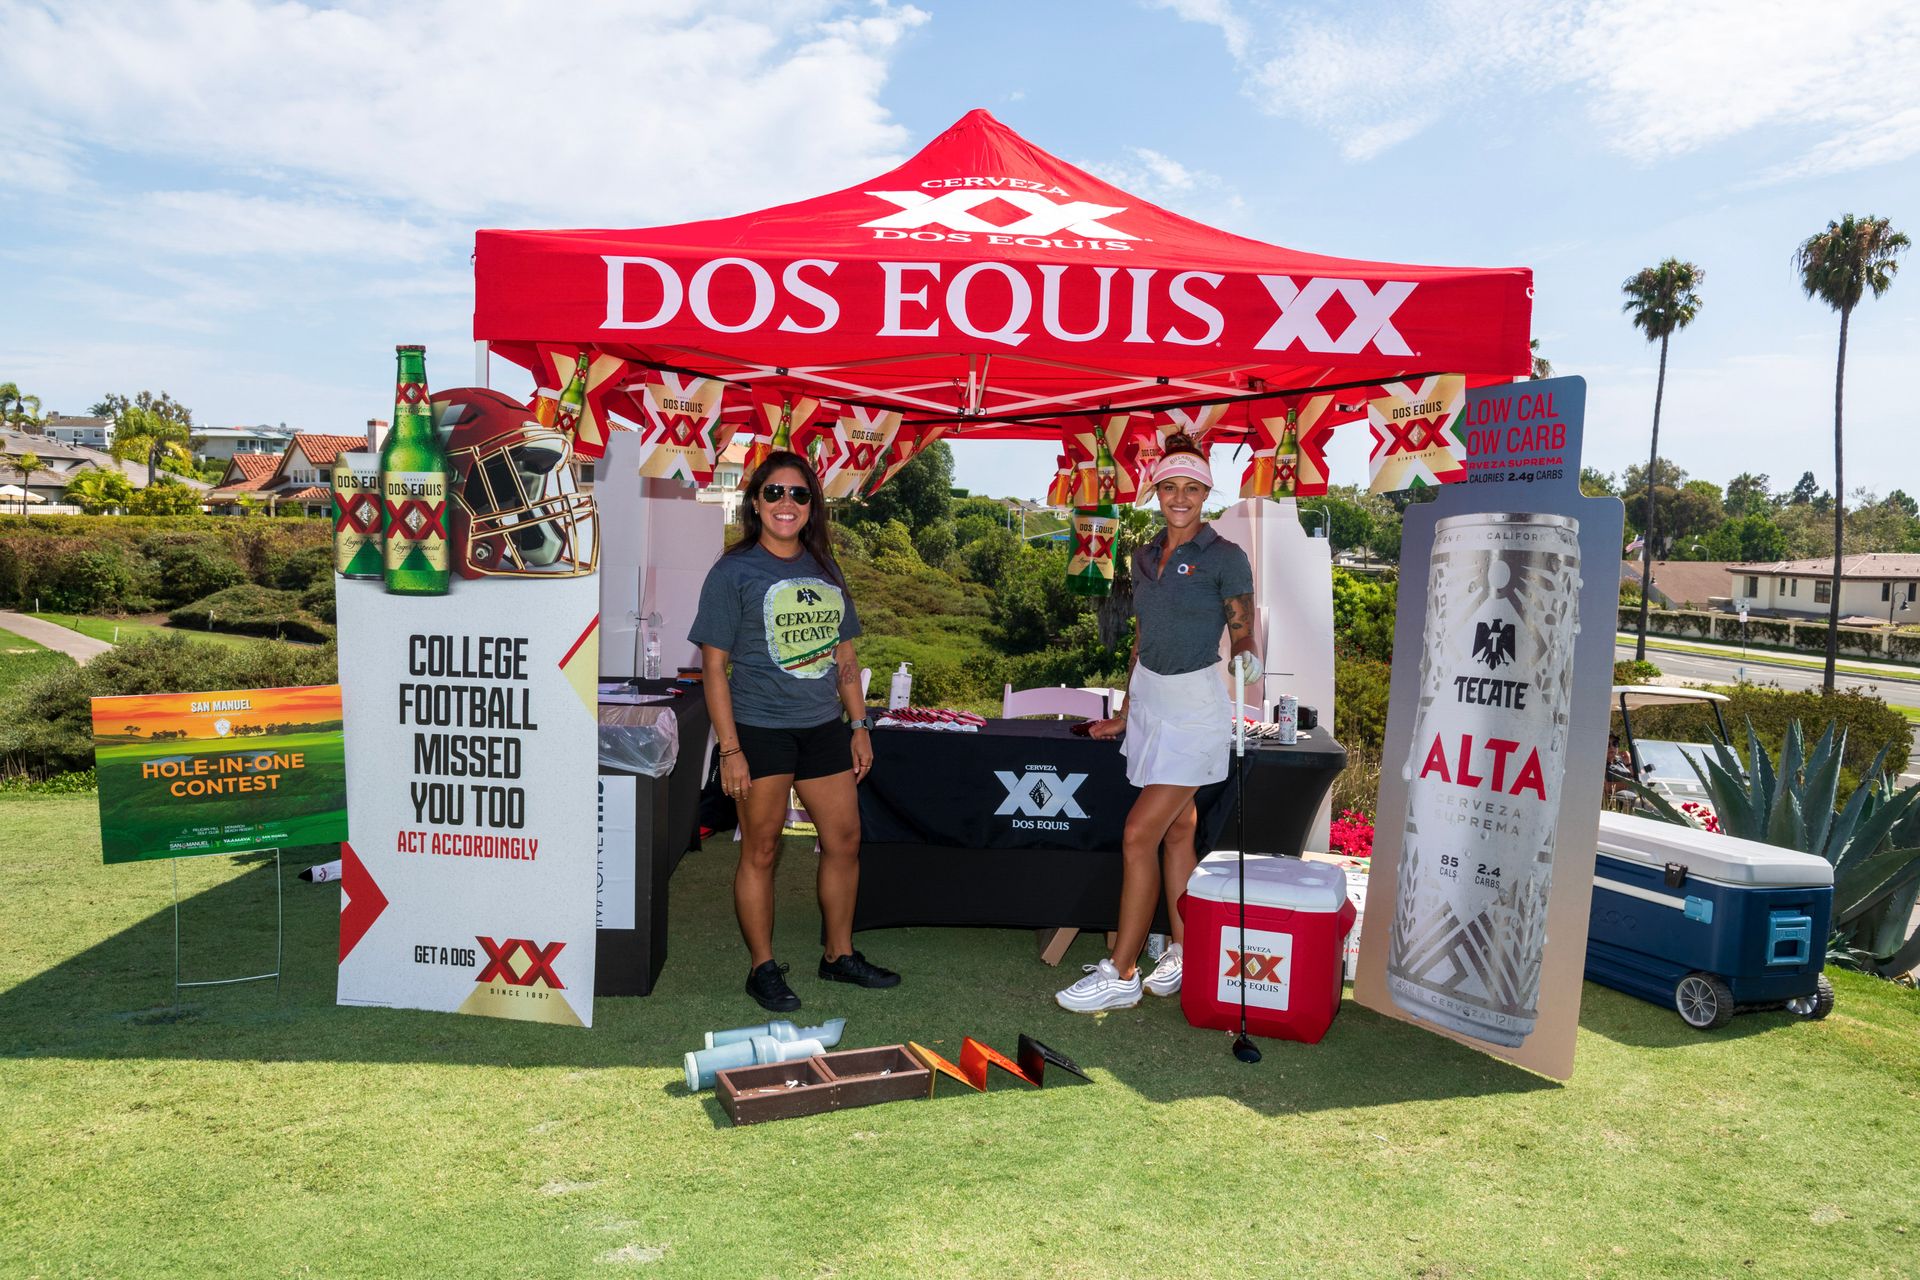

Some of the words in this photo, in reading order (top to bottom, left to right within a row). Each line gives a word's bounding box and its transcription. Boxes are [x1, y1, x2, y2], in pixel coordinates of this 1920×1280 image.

[920, 176, 1071, 197] CERVEZA
[873, 229, 972, 244] DOS
[987, 234, 1133, 251] EQUIS
[598, 253, 841, 335] DOS
[876, 260, 1226, 347] EQUIS
[1253, 274, 1420, 357] XX
[663, 398, 679, 410] DOS
[680, 400, 703, 413] EQUIS
[1392, 406, 1411, 419] DOS
[1413, 400, 1442, 415] EQUIS
[1465, 398, 1512, 426] LOW
[1517, 392, 1559, 420] CAL
[852, 430, 865, 440] DOS
[866, 432, 884, 442] EQUIS
[1467, 429, 1501, 457] OW
[1506, 423, 1567, 453] CARB
[1468, 461, 1506, 470] RVEZA
[1508, 457, 1564, 468] SUPREMA
[338, 476, 358, 488] DOS
[1470, 472, 1505, 483] CALORIES
[1508, 472, 1534, 482] 2.4g
[1536, 469, 1563, 480] CARBS
[388, 483, 408, 496] DOS
[411, 483, 442, 497] EQUIS
[1080, 523, 1093, 532] DOS
[775, 609, 840, 627] CERVEZA
[782, 625, 834, 644] TECATE
[409, 634, 529, 680] COLLEGE
[1454, 676, 1529, 710] TECATE
[191, 702, 210, 713] SAN
[213, 699, 252, 711] MANUEL
[399, 683, 538, 731] FOOTBALL
[414, 733, 522, 779] MISSED
[142, 753, 305, 779] HOLE-IN-ONE
[1419, 732, 1547, 801] ALTA
[170, 774, 281, 797] CONTEST
[410, 782, 465, 826] YOU
[471, 785, 525, 829] TOO
[1435, 794, 1520, 819] CERVEZA
[1012, 819, 1035, 829] DOS
[1037, 820, 1070, 830] EQUIS
[1434, 809, 1519, 836] SUPREMA
[397, 830, 428, 853] ACT
[431, 833, 538, 861] ACCORDINGLY
[1440, 854, 1459, 868] 85
[1477, 863, 1501, 877] 2.4
[1440, 867, 1457, 879] CALS
[1475, 875, 1500, 889] CARBS
[414, 945, 438, 964] GET
[440, 947, 448, 965] A
[450, 948, 475, 967] DOS
[490, 988, 520, 997] SINCE
[1249, 982, 1279, 993] EQUIS
